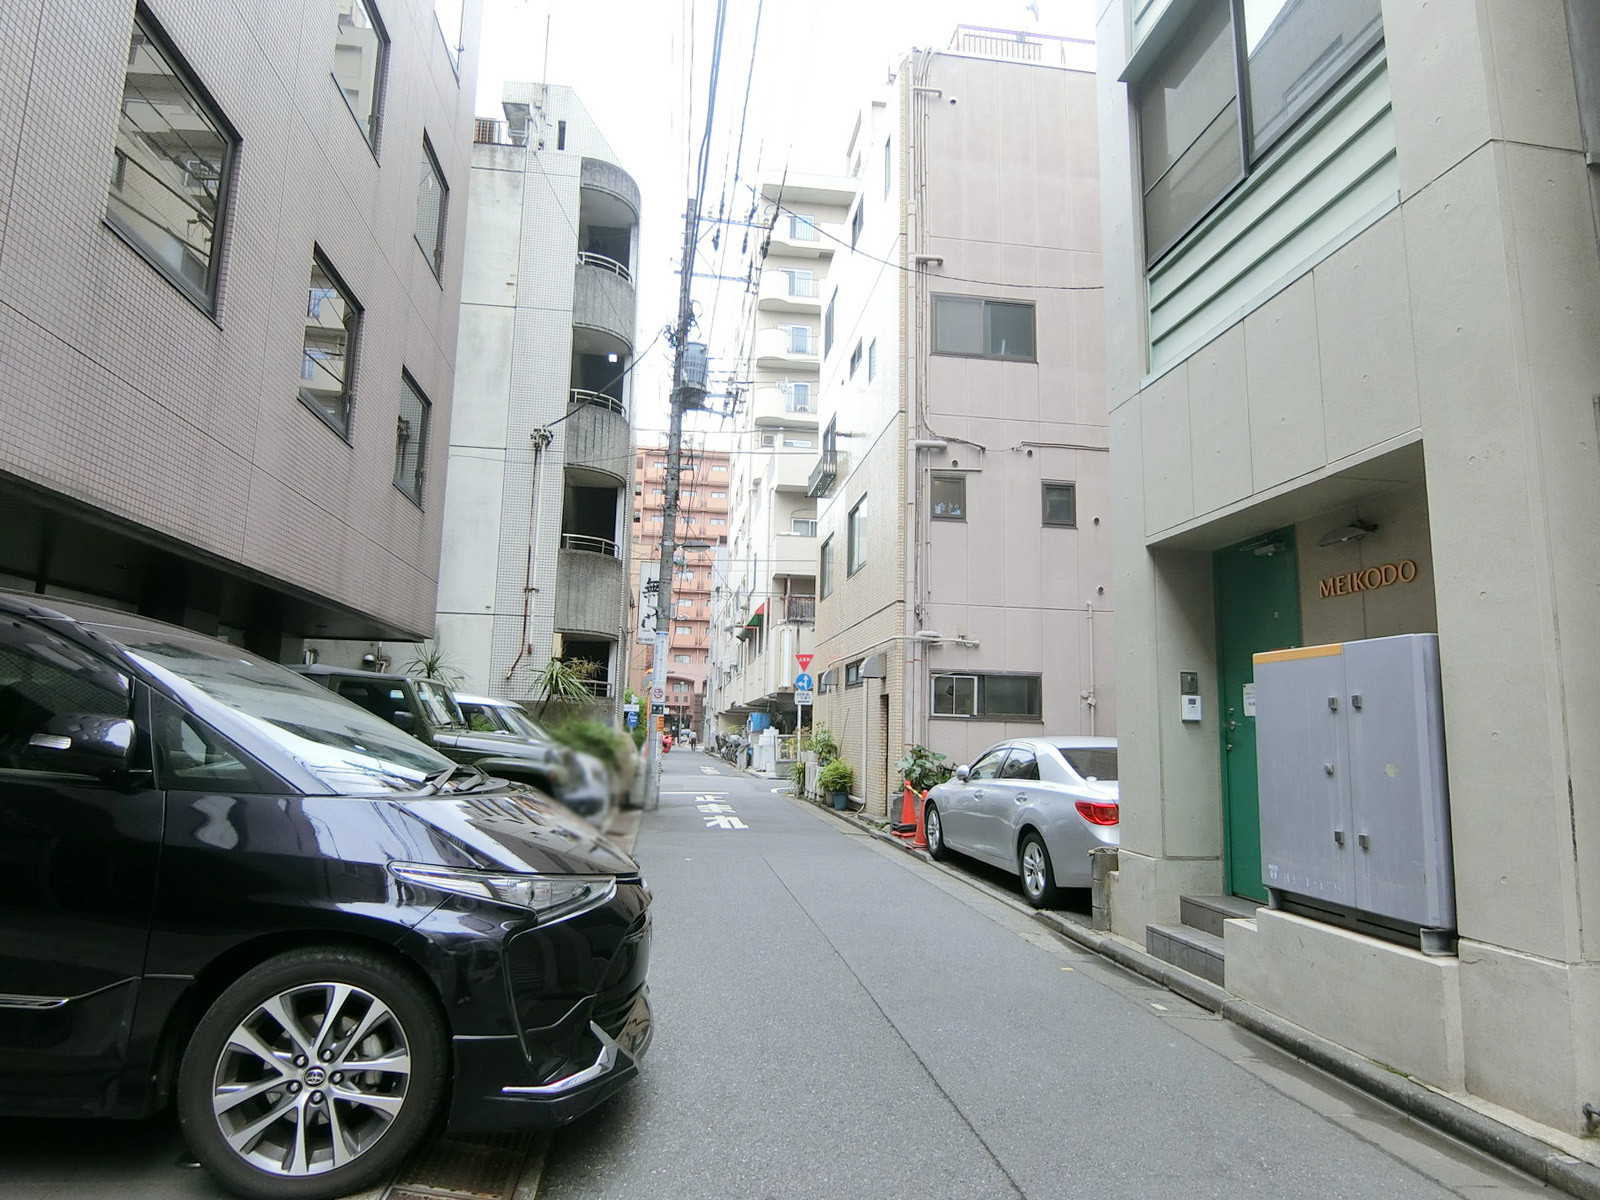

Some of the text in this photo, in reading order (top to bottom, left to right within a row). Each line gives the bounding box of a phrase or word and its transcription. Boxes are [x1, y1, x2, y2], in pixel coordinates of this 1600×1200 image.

[1319, 560, 1417, 599] MEIKODO
[695, 795, 750, 829] 止まれ
